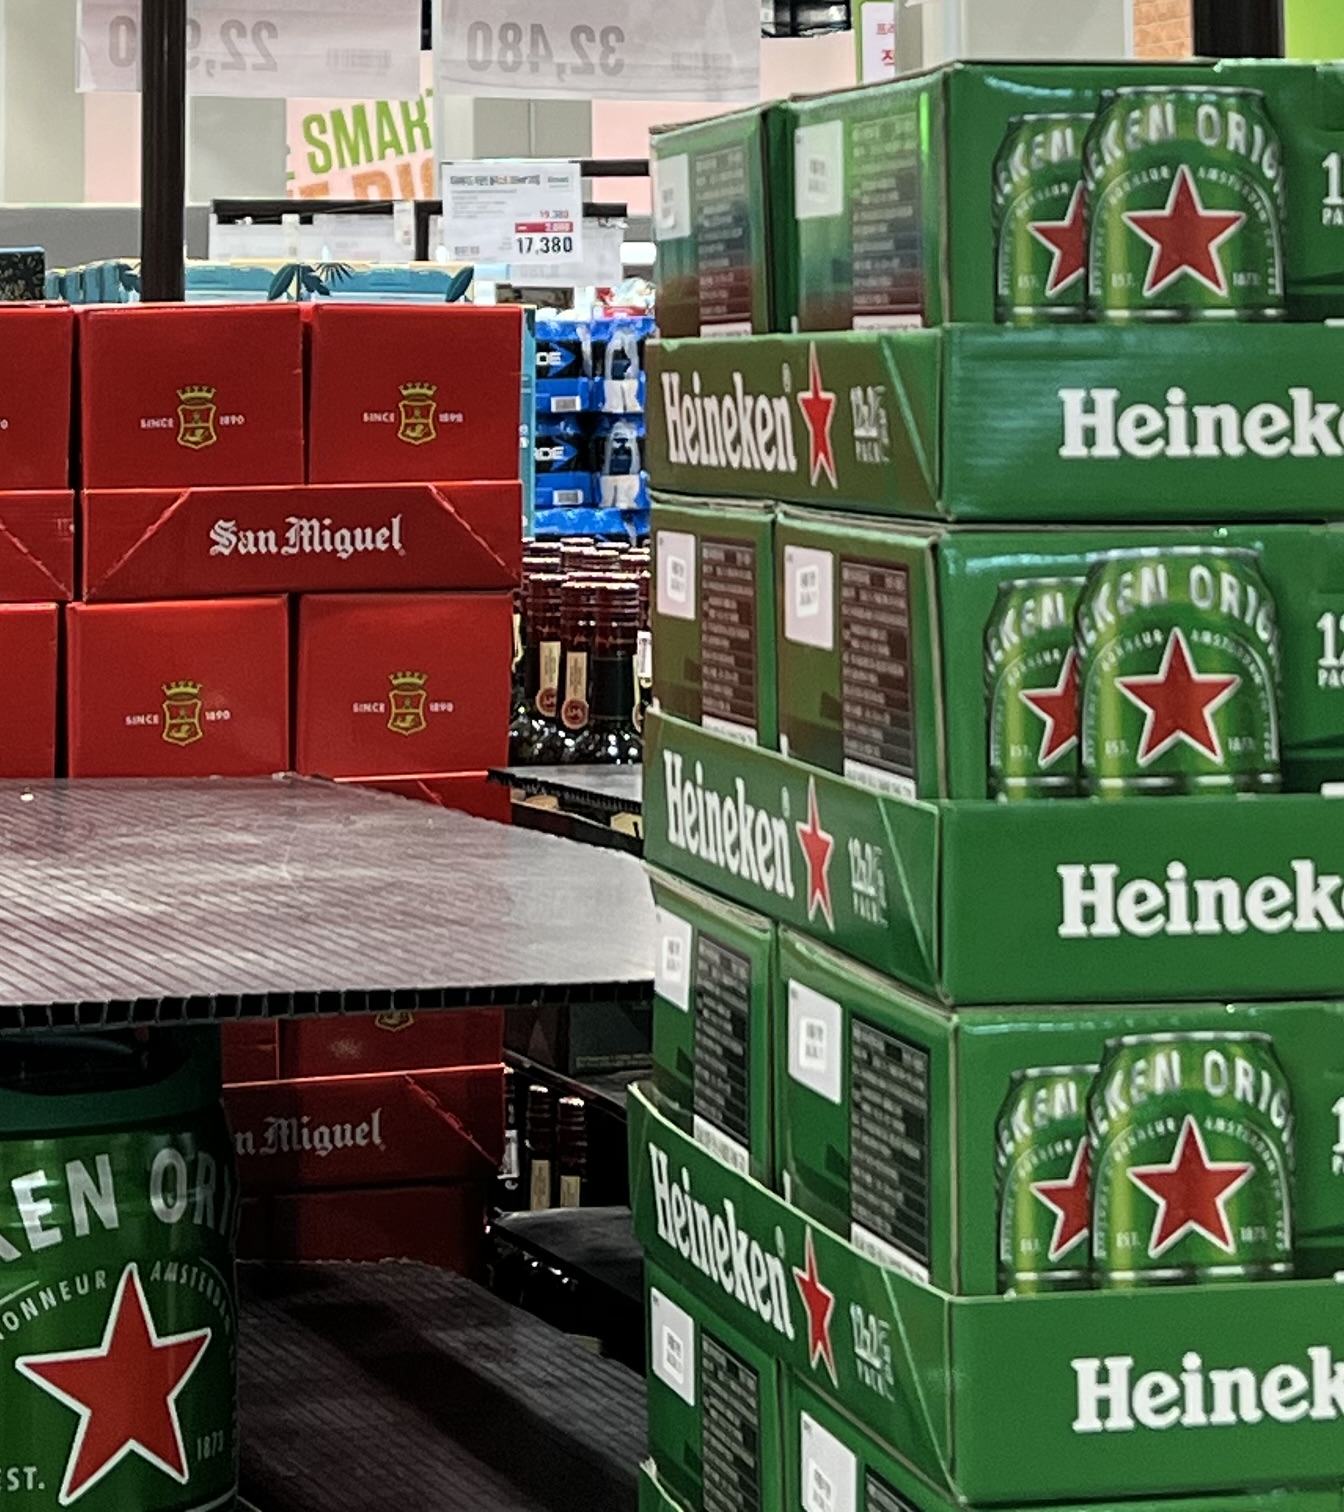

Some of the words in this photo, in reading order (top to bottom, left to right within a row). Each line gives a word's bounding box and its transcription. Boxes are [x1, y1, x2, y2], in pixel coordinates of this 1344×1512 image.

[302, 96, 434, 175] SMAR
[516, 236, 574, 256] 17,380
[140, 417, 174, 430] SINCE
[363, 412, 395, 424] SINCE
[209, 518, 278, 558] San
[285, 514, 403, 561] Miguel
[353, 702, 386, 714] SINCE
[429, 702, 454, 714] 1890
[125, 714, 160, 726] SINCE
[205, 709, 231, 721] 1890
[260, 1109, 384, 1157] Miguel
